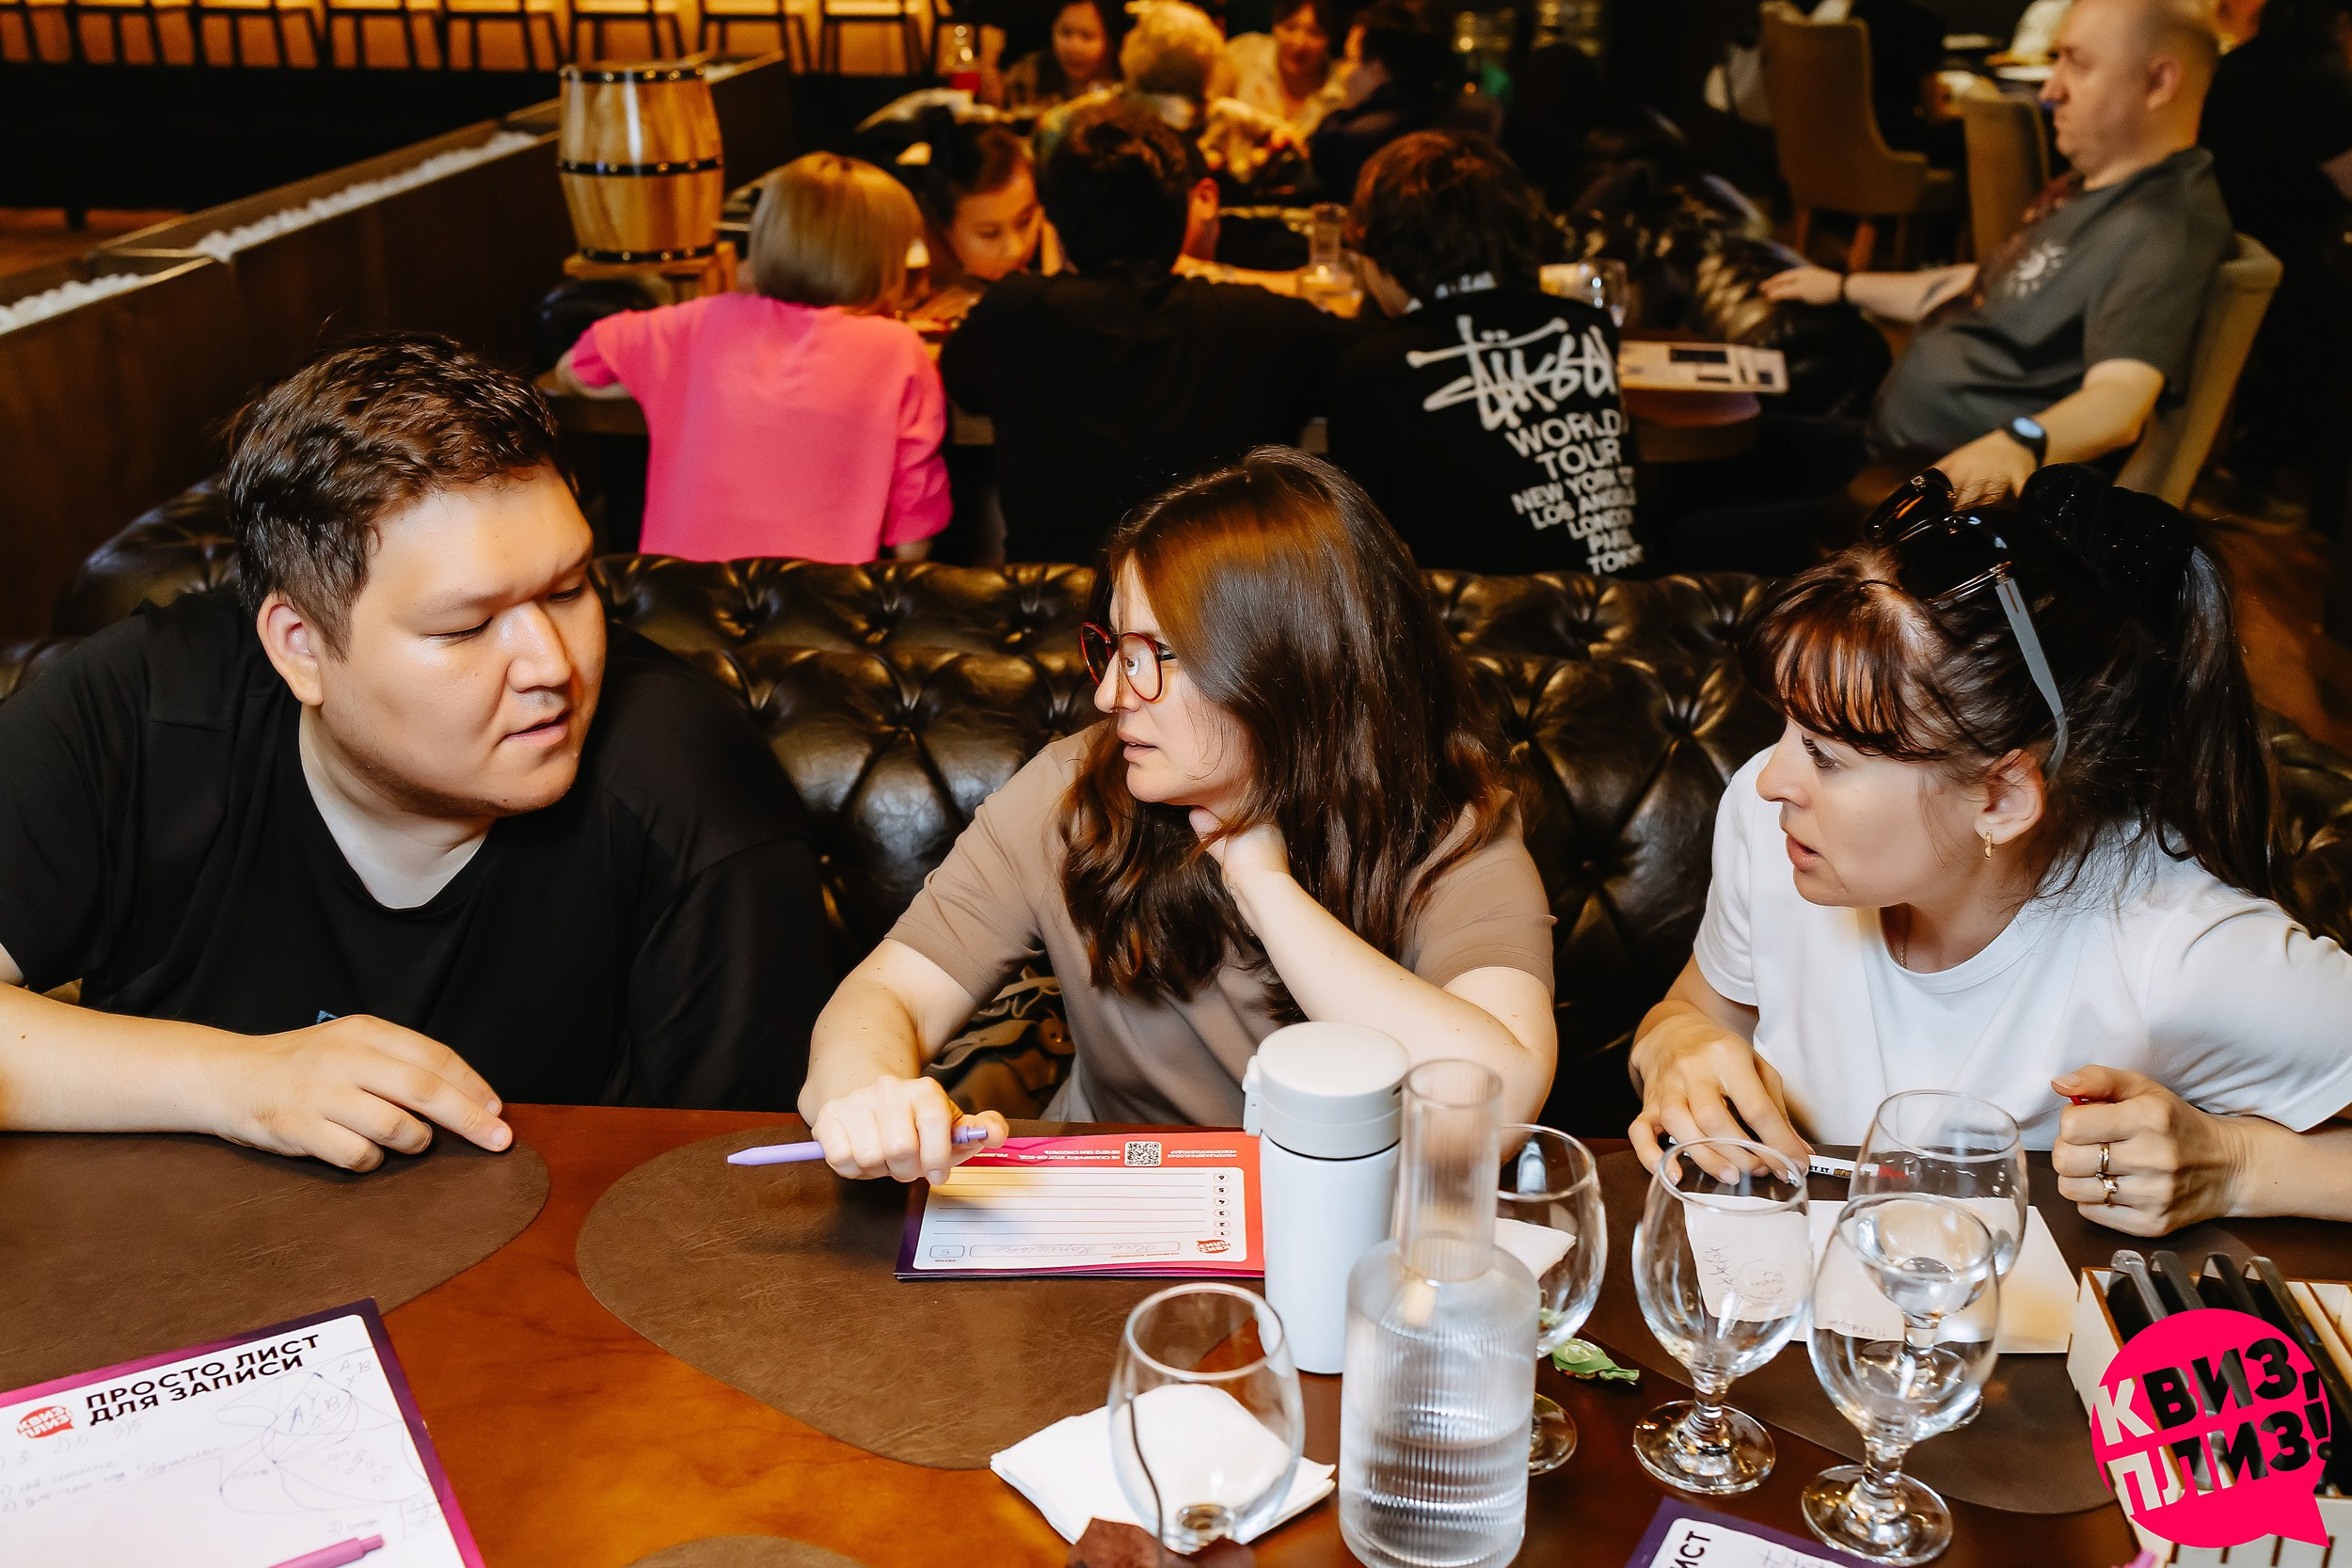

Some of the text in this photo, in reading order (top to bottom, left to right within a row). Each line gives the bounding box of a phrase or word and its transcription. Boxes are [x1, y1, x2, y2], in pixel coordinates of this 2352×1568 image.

[1504, 408, 1621, 458] WORLD
[1534, 437, 1622, 481] TOUR
[1511, 482, 1565, 515] NEW
[86, 1334, 320, 1409] ПРОСТО ЛИСТ
[89, 1354, 304, 1426] ДЛЯ ЗАПИСИ
